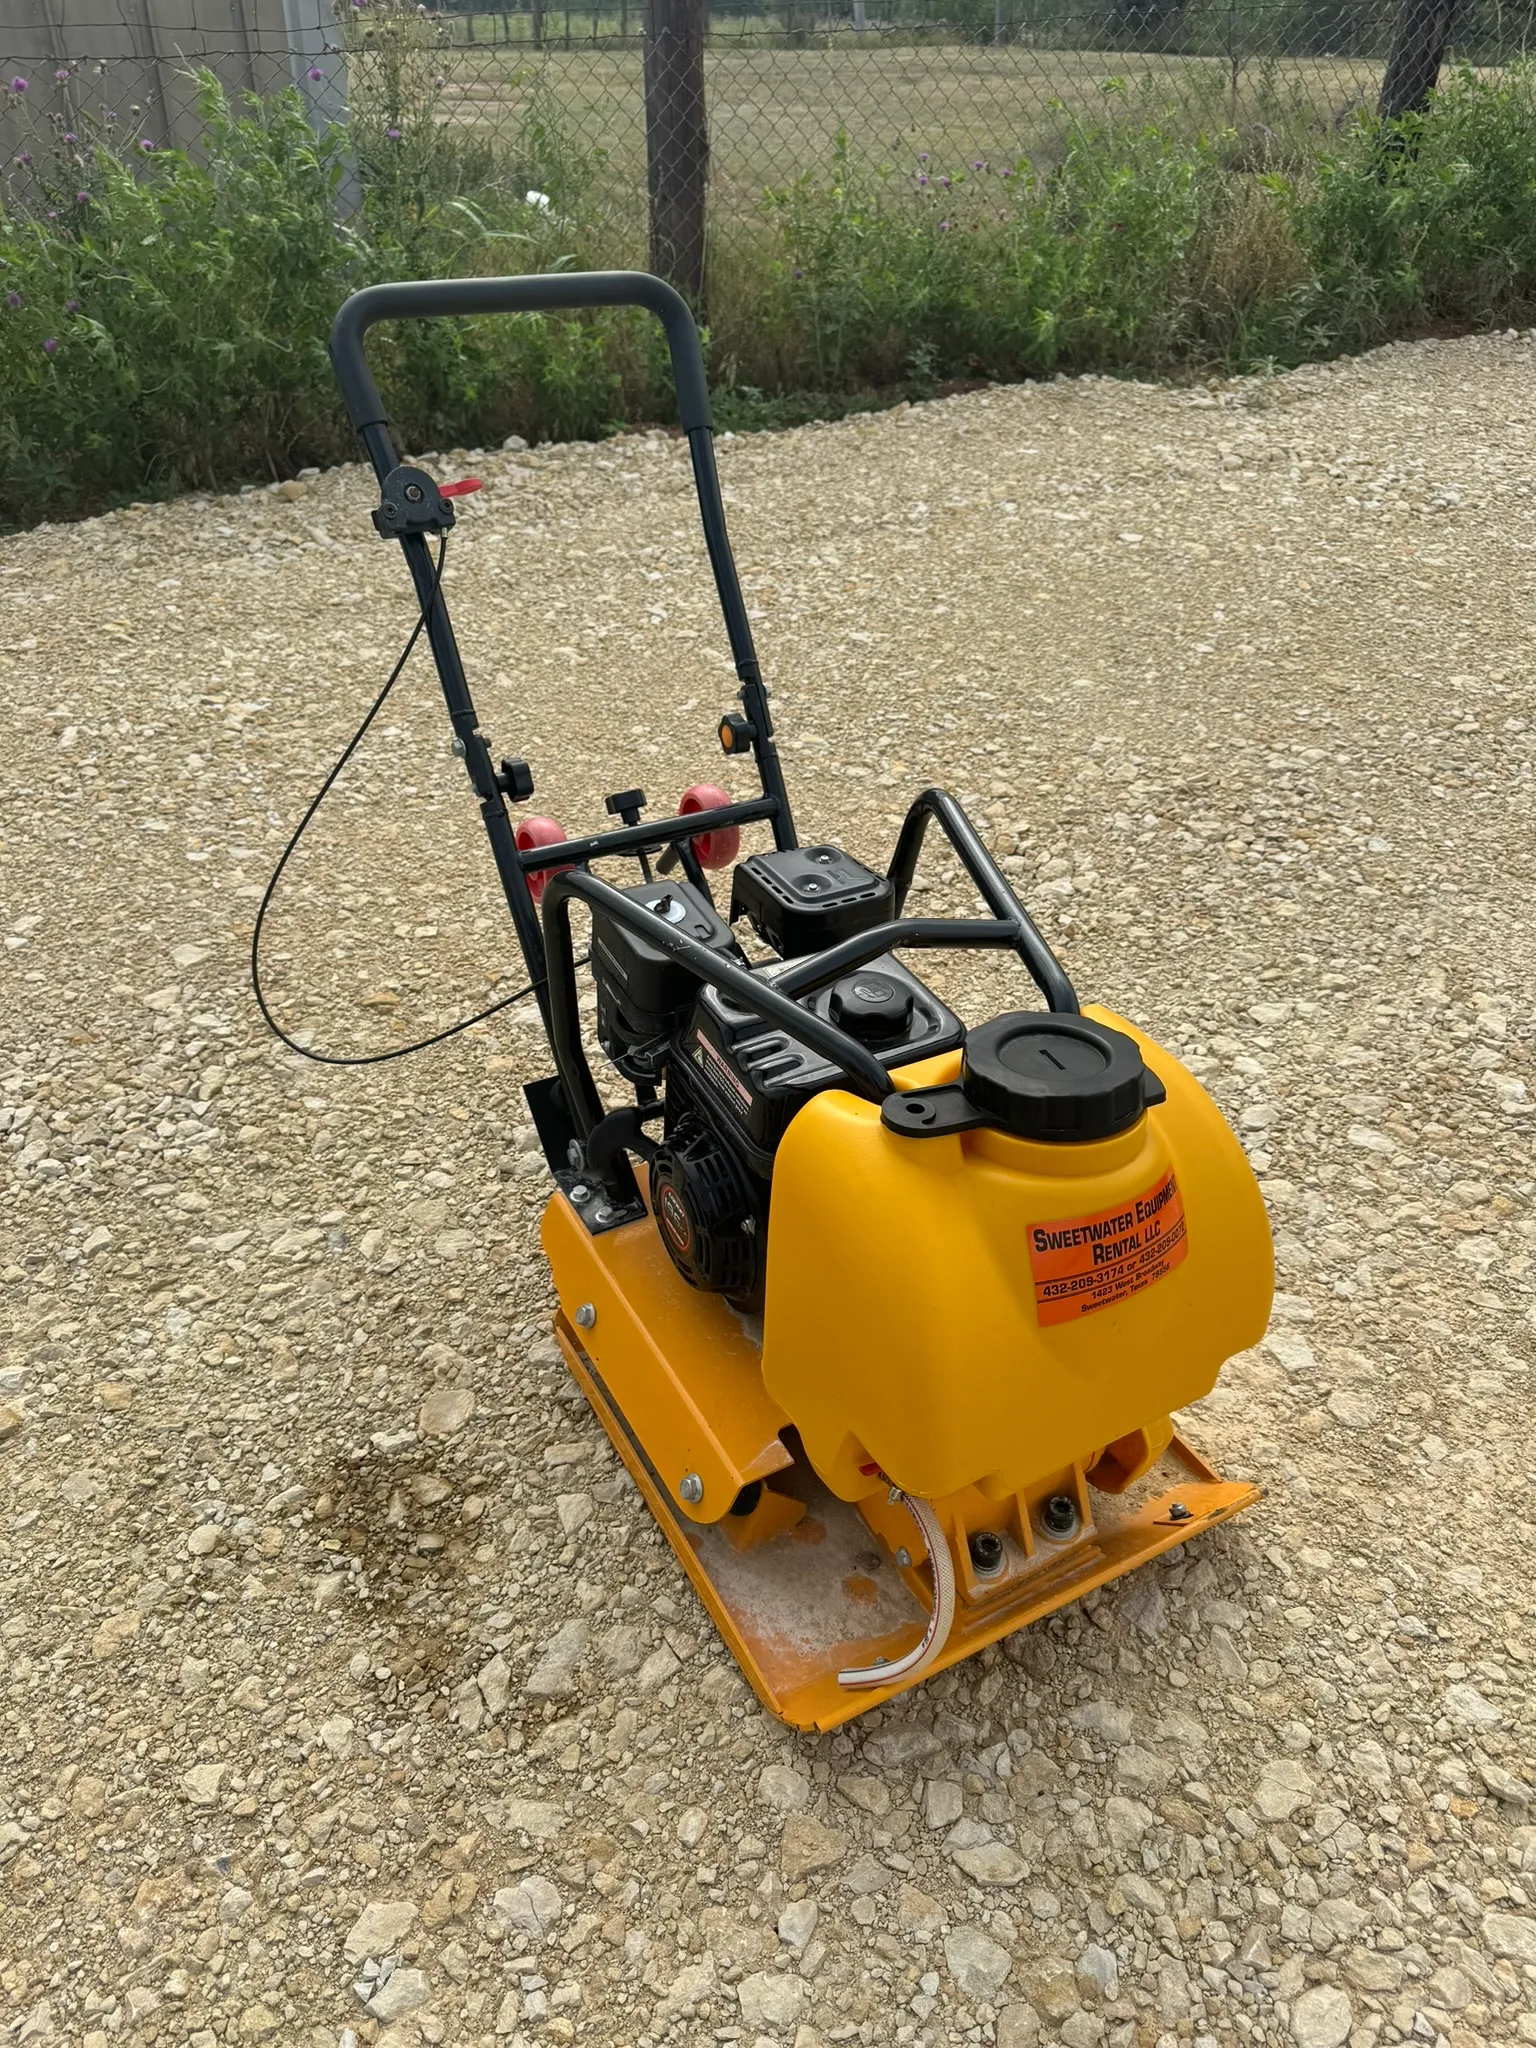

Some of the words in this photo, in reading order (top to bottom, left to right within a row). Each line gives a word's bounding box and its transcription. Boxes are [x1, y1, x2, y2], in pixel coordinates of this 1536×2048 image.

[716, 1055, 741, 1088] WARNING
[1033, 1212, 1134, 1252] SWEETWATER
[1135, 1173, 1178, 1224] EQUIPMEN
[1092, 1232, 1142, 1265] RENTAL
[1144, 1219, 1161, 1244] LLC
[1043, 1264, 1124, 1297] 432-209-3174
[1126, 1261, 1137, 1273] or
[1080, 1290, 1127, 1313] Sweetwater,
[1130, 1279, 1148, 1293] Texas
[1091, 1286, 1113, 1300] 1423
[1114, 1278, 1134, 1291] West
